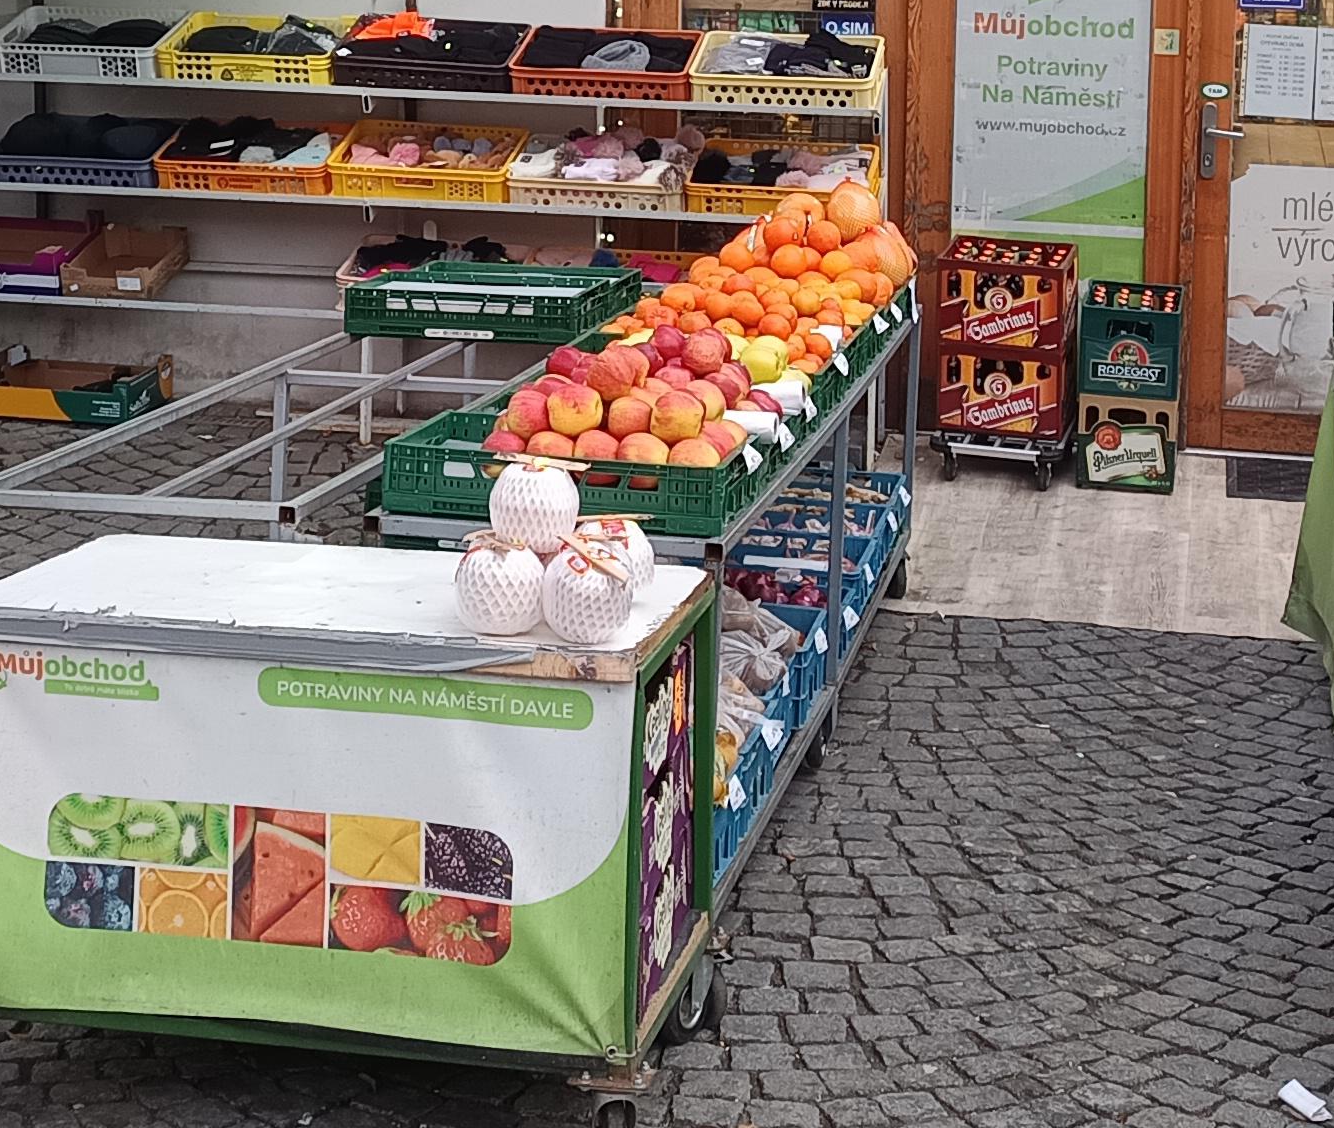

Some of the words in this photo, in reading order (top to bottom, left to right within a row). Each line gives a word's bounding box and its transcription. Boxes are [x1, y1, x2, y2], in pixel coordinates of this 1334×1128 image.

[842, 21, 869, 35] SIM
[974, 11, 1135, 40] Můjobchod
[997, 55, 1109, 82] Potraviny
[982, 84, 1014, 103] Na
[975, 120, 1127, 137] www.mujobchod.cz
[967, 310, 1034, 341] Gambrinus
[1097, 364, 1162, 382] RADEGAST
[967, 396, 1034, 426] Gambrinus
[1093, 450, 1125, 472] Pilsner
[1124, 447, 1157, 464] Urquell
[277, 680, 383, 702] POTRAVINY
[389, 688, 417, 706] NA
[422, 686, 506, 714] NÁMĚSTÍ
[510, 698, 574, 719] DAVLE
